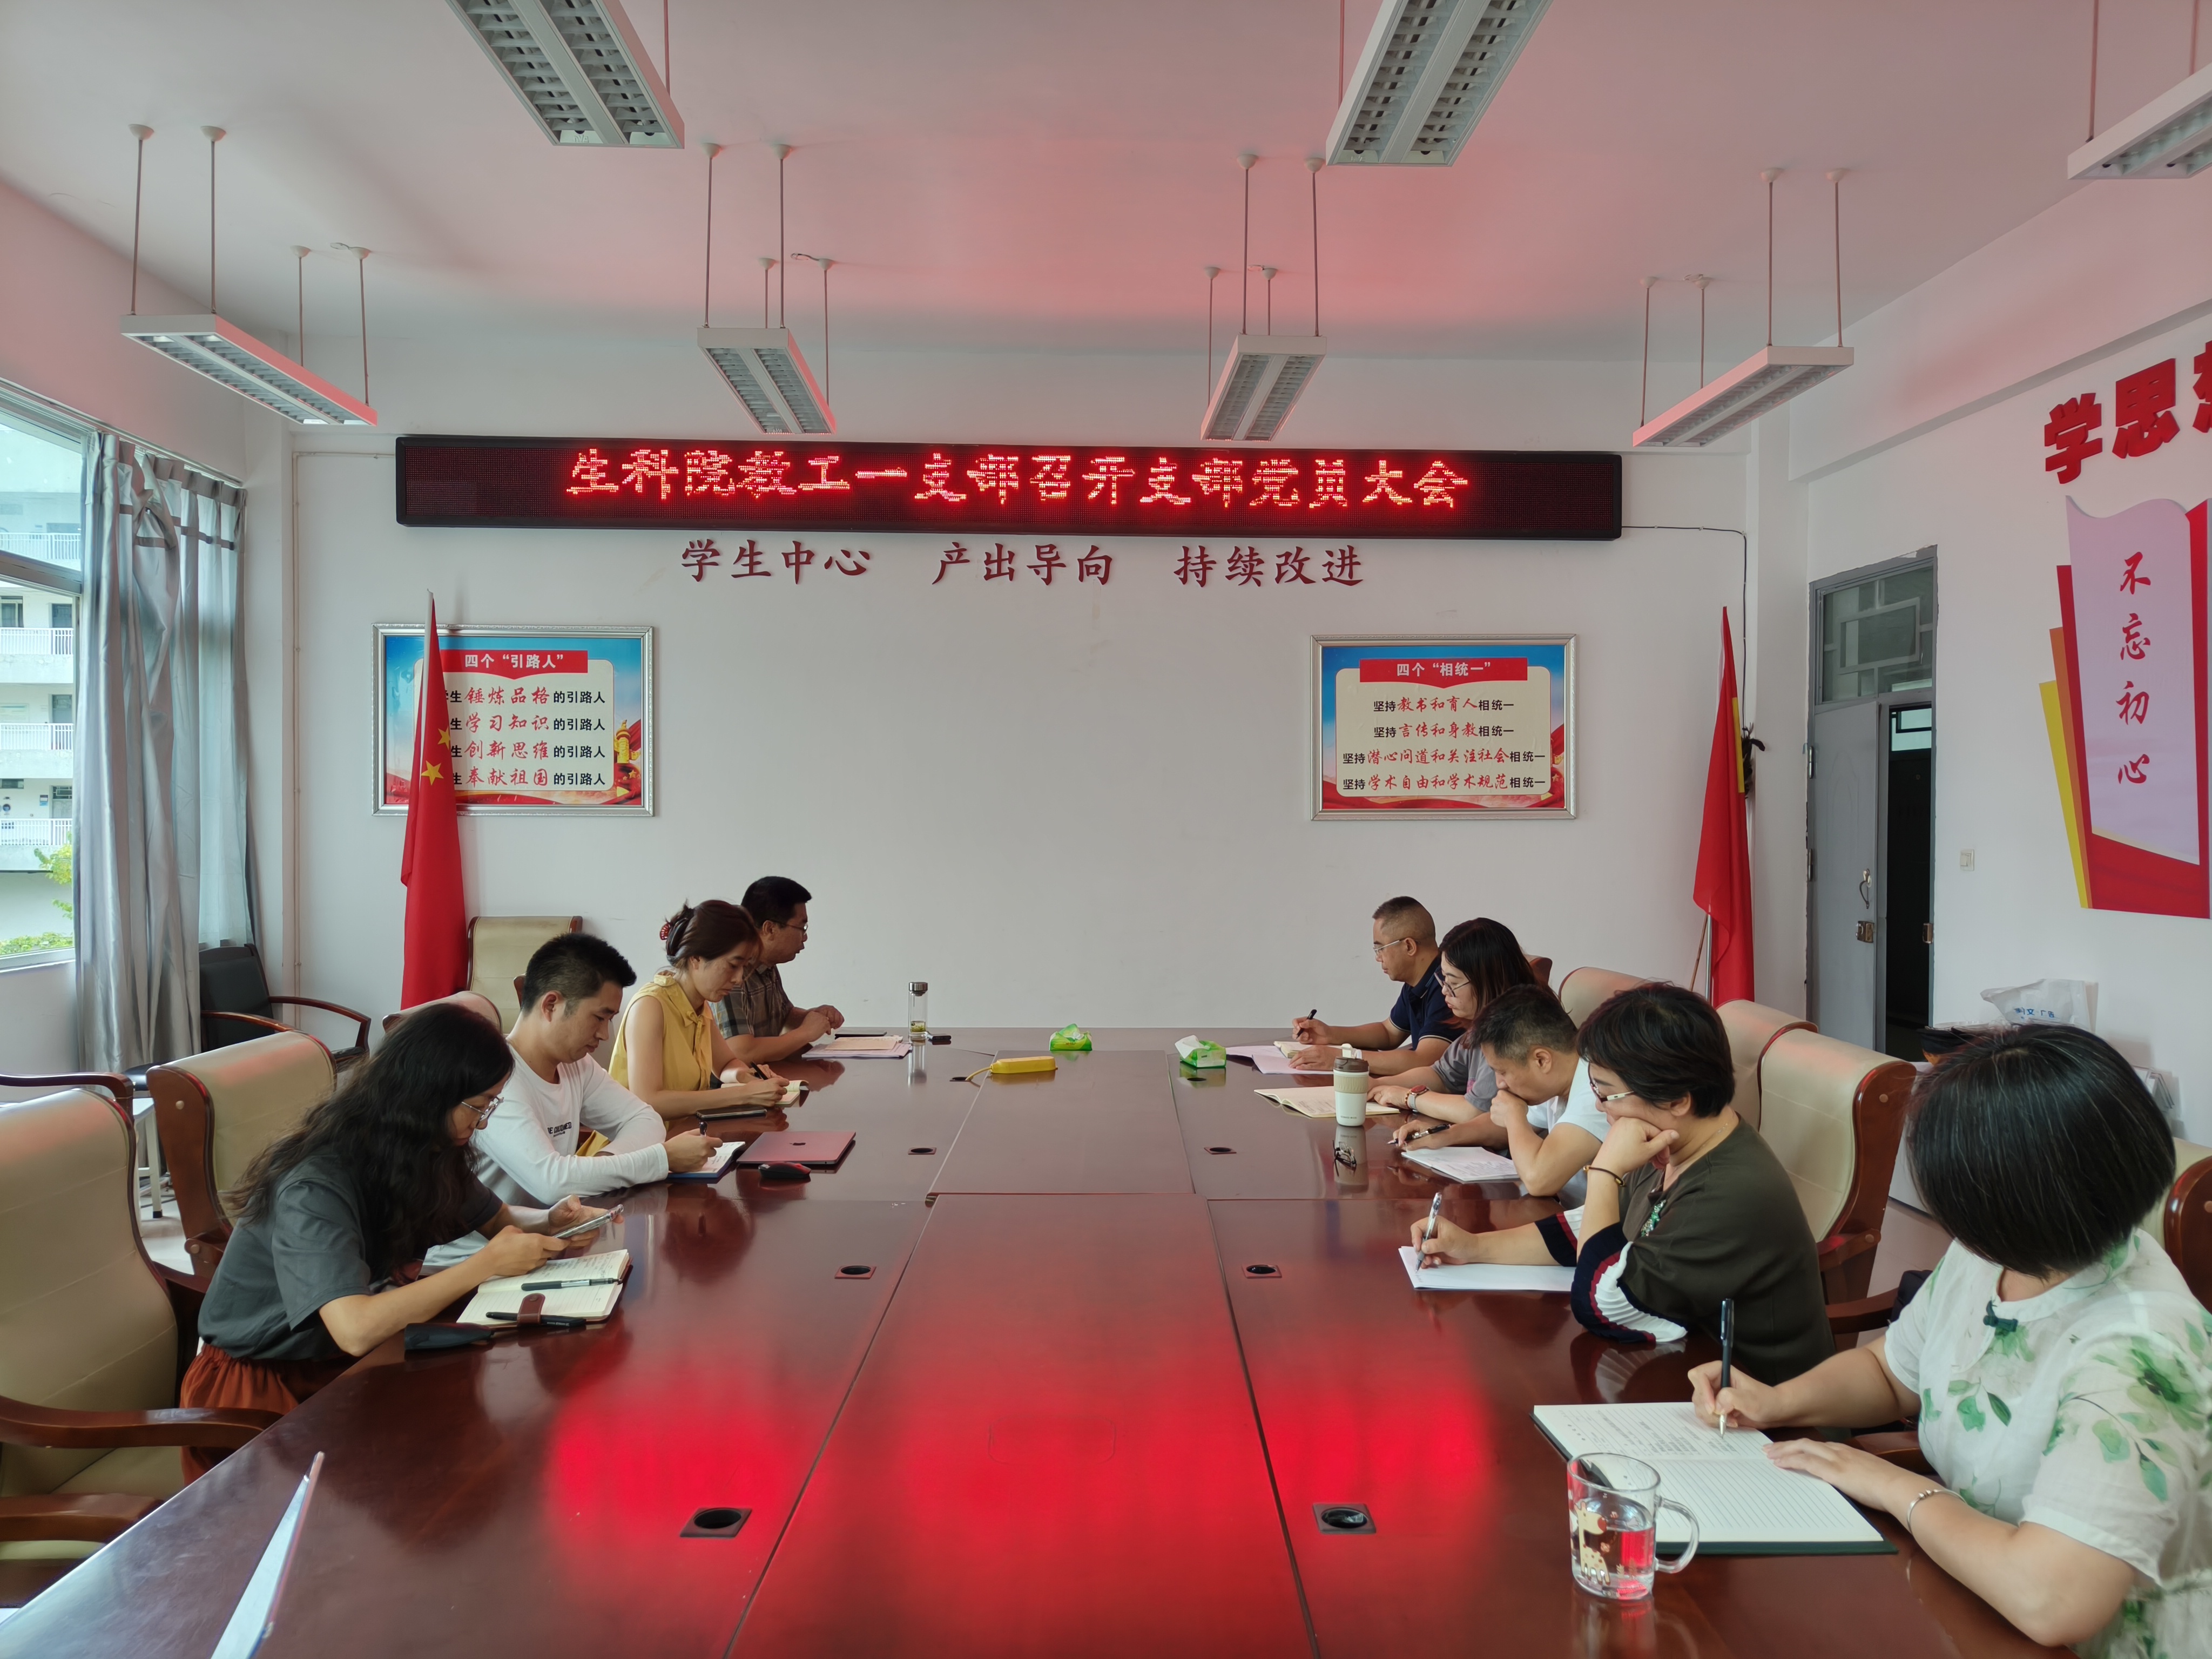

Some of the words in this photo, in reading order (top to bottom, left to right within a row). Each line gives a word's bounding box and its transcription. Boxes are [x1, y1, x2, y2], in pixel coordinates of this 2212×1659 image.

[565, 448, 1469, 509] 生科院教工一支部召开支部党员大会
[682, 540, 871, 584] 学生中心
[933, 542, 1114, 586] 产出导向
[1174, 545, 1363, 588] 持续改进
[2116, 551, 2153, 786] 不忘初心
[445, 686, 606, 706] 生锤炼品格的引路人
[1373, 696, 1514, 713] 坚持教书和育人相统一
[1373, 721, 1514, 739] 坚持言传和身教相统一
[1343, 747, 1546, 765] 坚持潜心问道和关注社会相统一
[1343, 773, 1546, 791] 坚持学术自由和学术规范相统一
